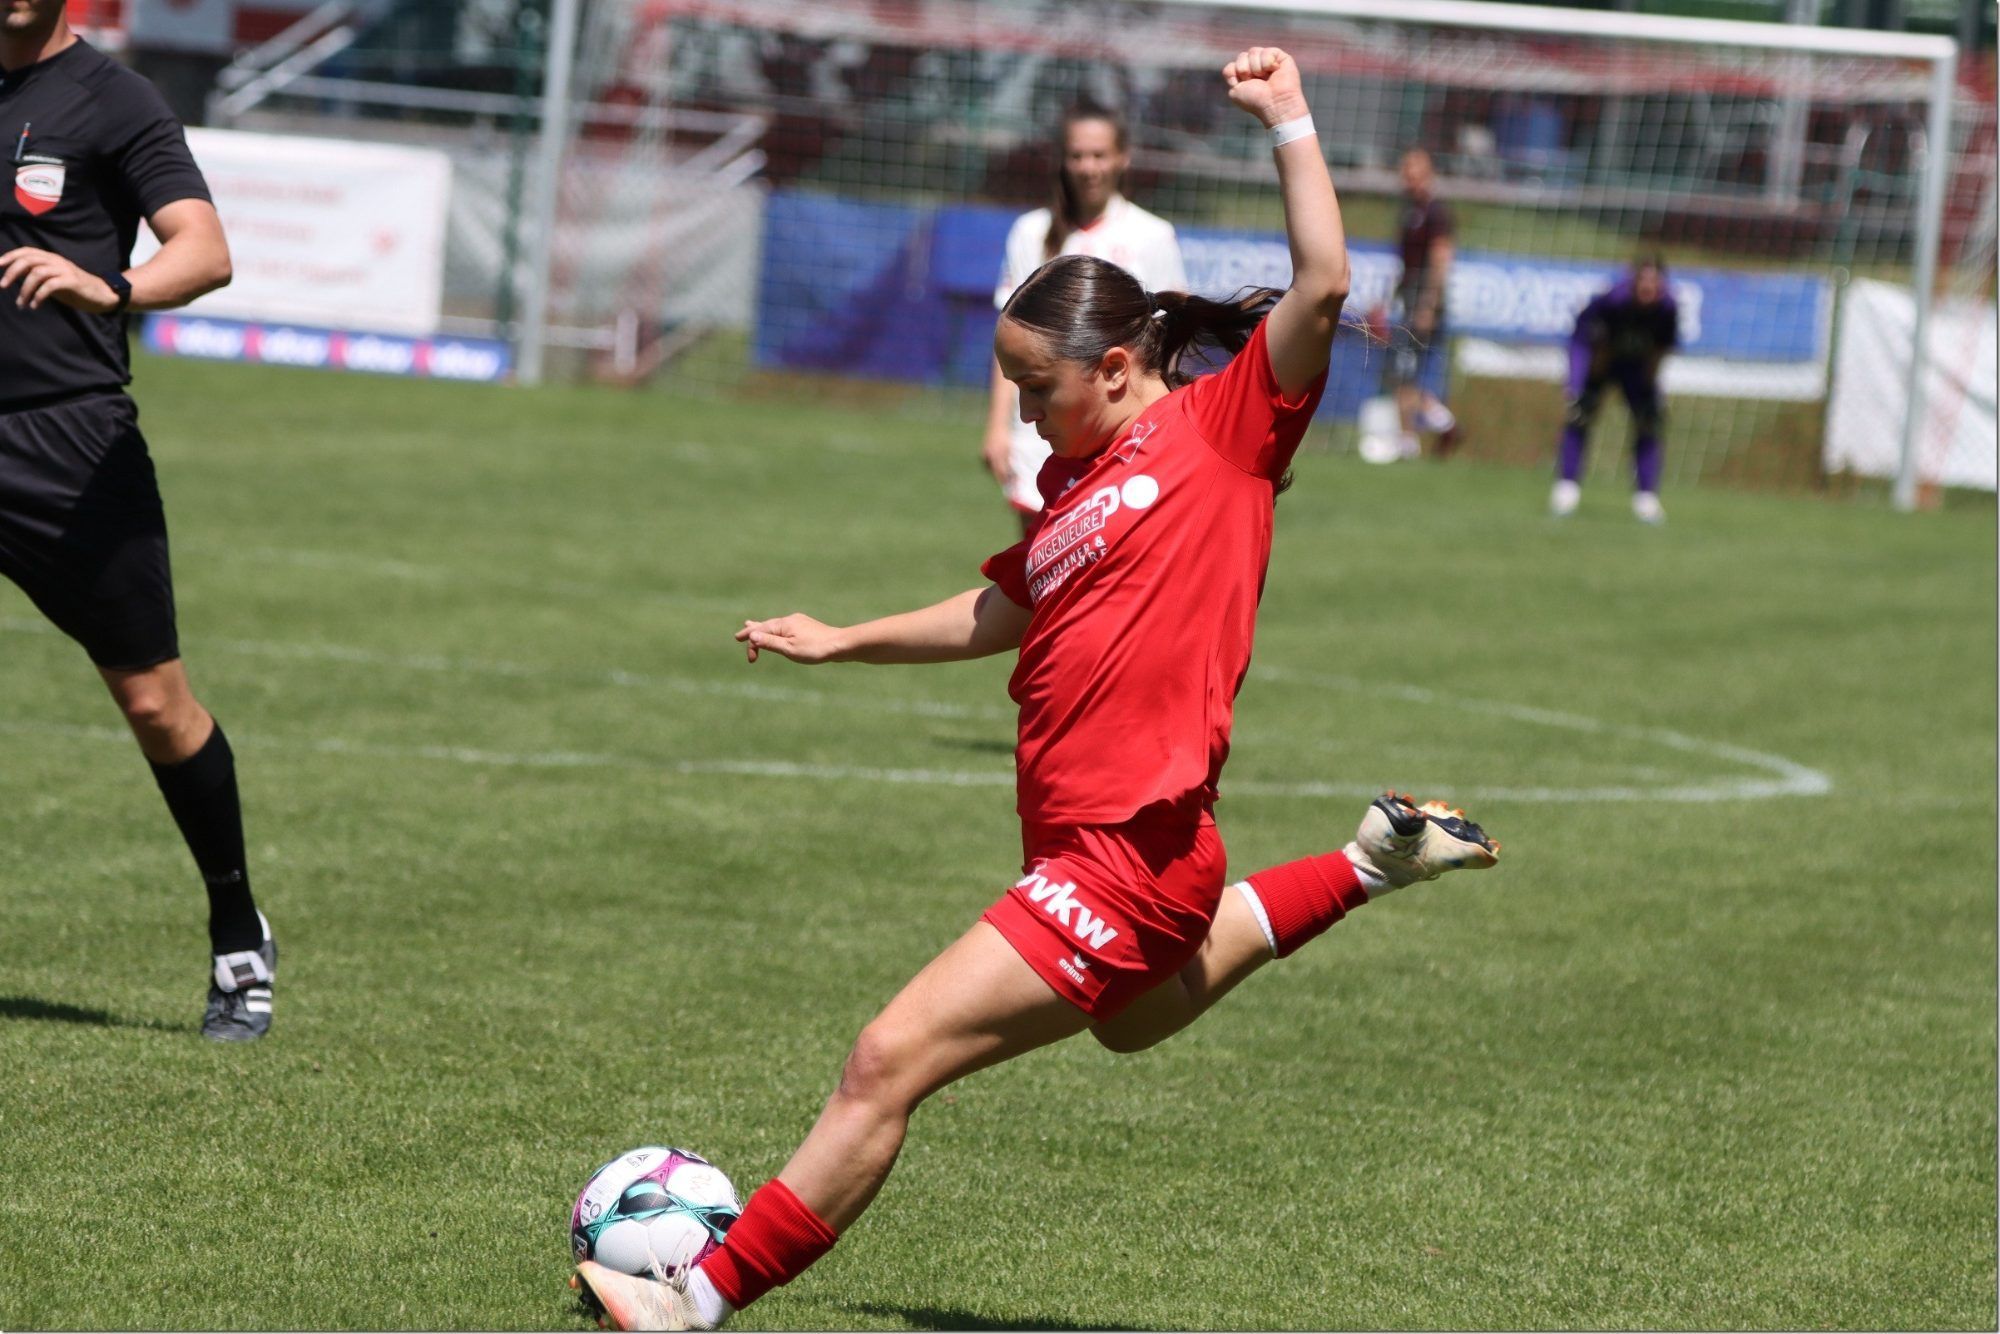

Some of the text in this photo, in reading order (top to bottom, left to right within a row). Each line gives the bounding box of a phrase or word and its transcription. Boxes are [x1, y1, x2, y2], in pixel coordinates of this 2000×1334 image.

[1034, 510, 1101, 567] INGENIEURE
[1095, 535, 1107, 548] &
[1057, 957, 1086, 985] erima
